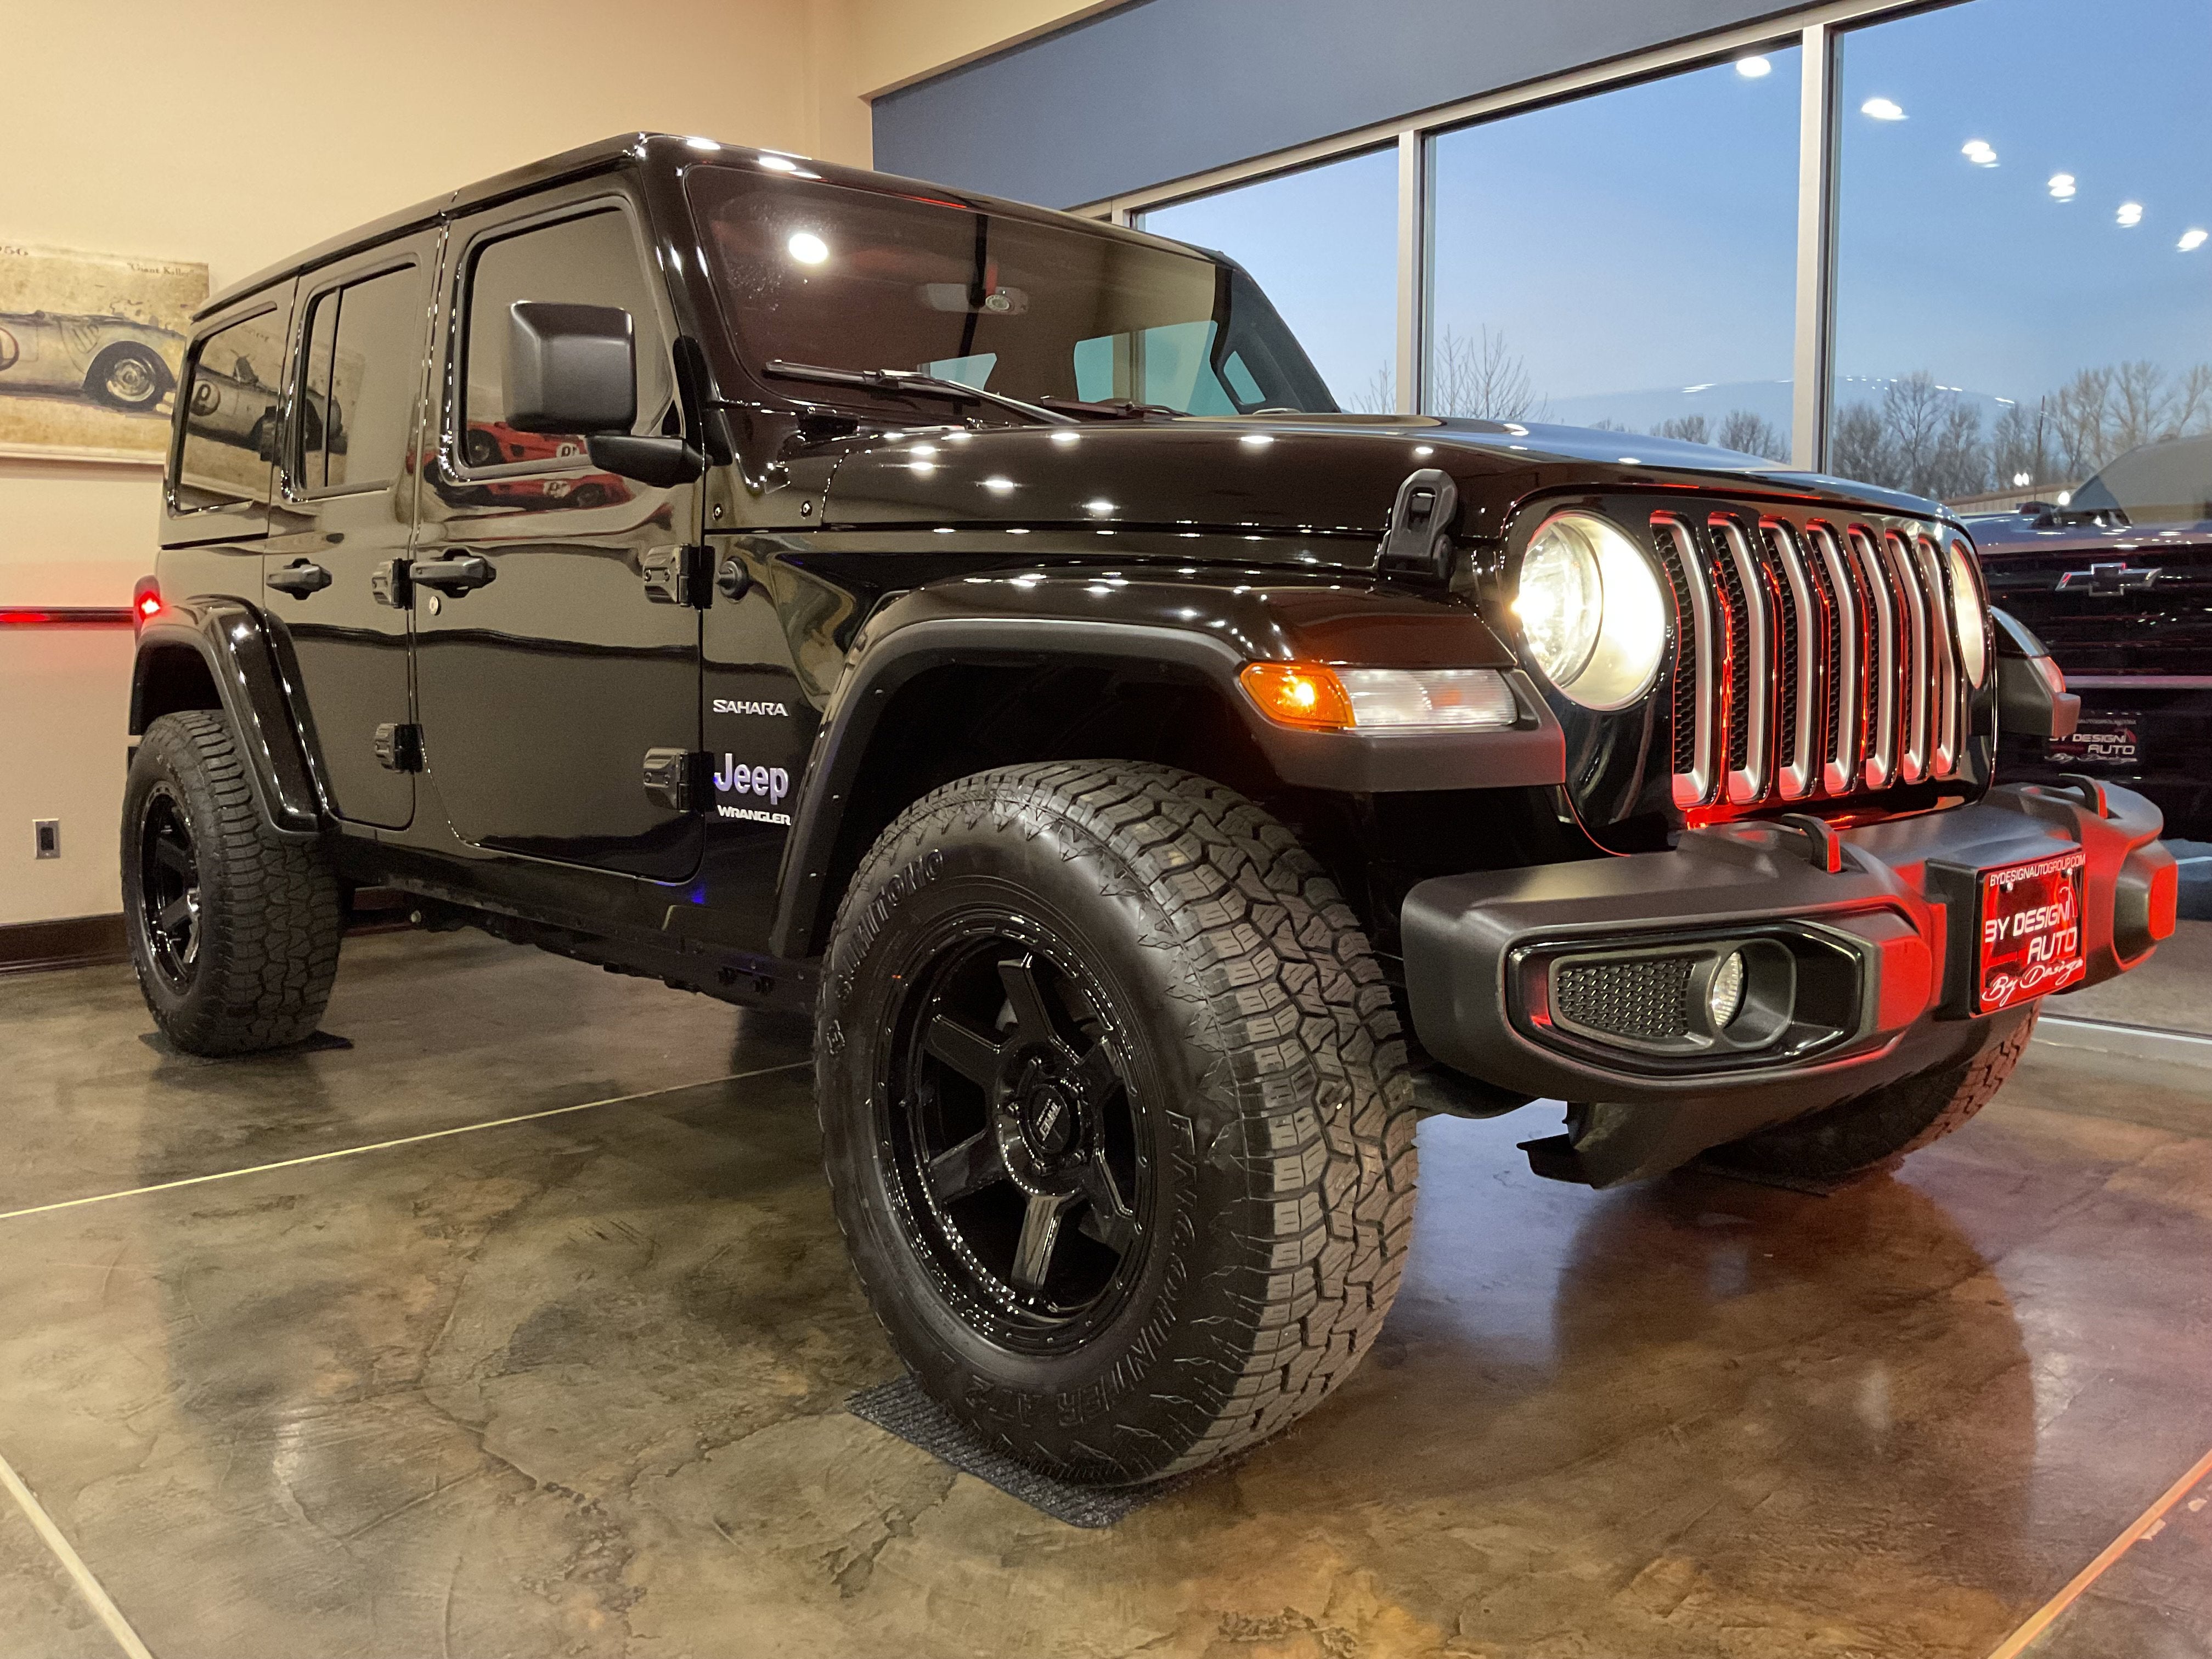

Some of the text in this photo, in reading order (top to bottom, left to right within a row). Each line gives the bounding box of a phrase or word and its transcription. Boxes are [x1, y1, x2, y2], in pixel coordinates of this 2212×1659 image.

[713, 699, 789, 716] SAHARA
[2087, 744, 2135, 755] AUTO
[714, 753, 788, 805] Jeep
[717, 804, 792, 826] WRANGLER
[1989, 853, 2086, 888] BYDESIGNAUTOGROUP.COM
[1984, 901, 2070, 943] BY DESIGN
[2027, 926, 2078, 965] AUTO
[1982, 974, 2019, 1007] By
